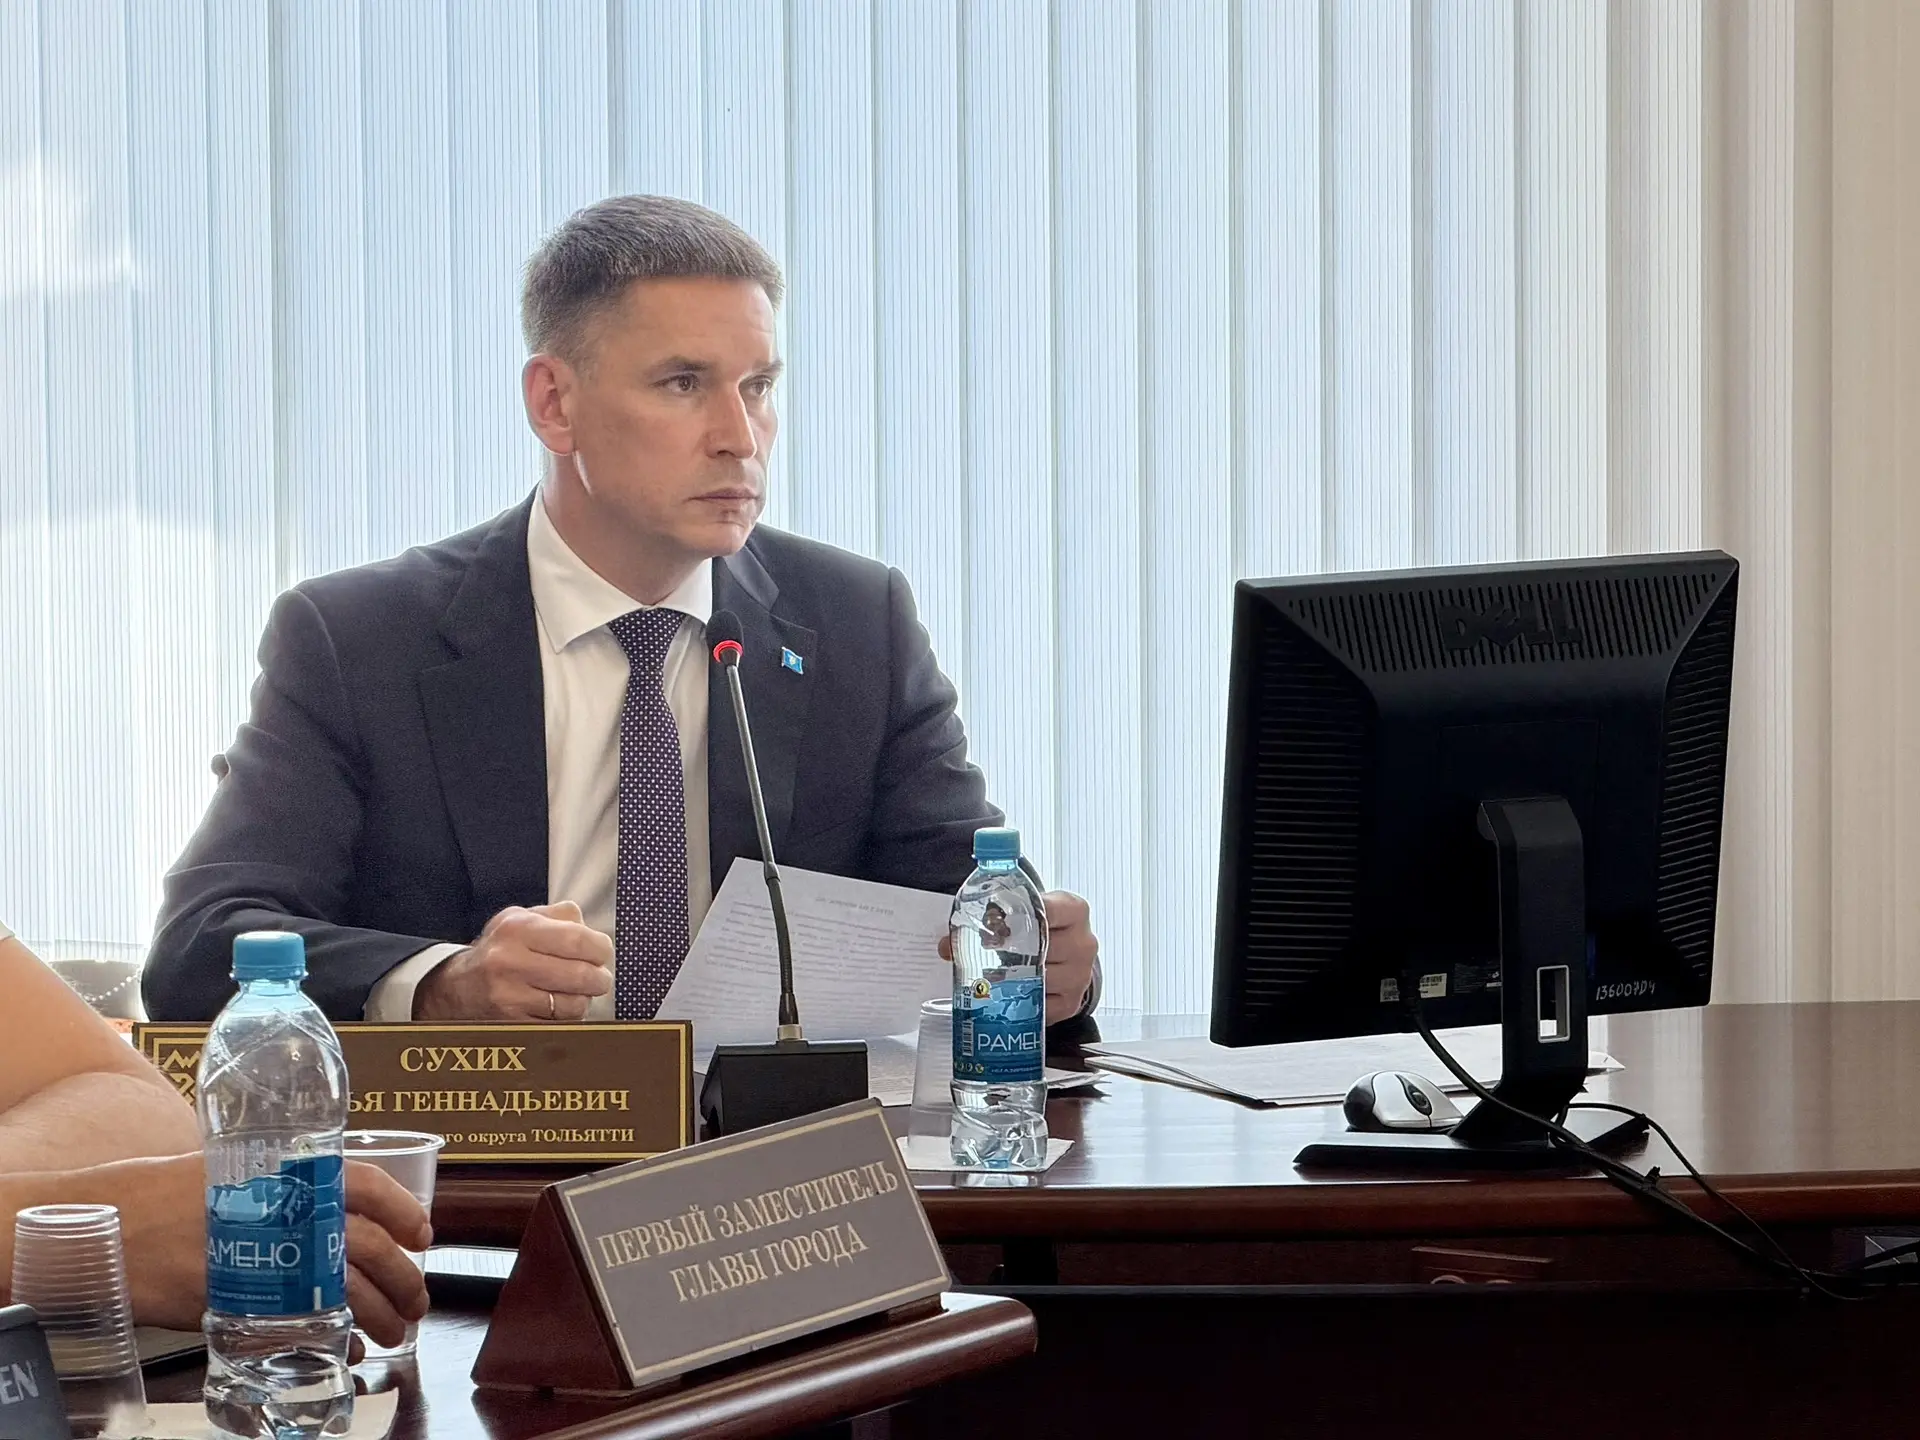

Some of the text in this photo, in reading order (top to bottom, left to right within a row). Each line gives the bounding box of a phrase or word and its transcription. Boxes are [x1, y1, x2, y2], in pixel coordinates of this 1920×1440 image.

[400, 1047, 527, 1072] СУХИХ
[342, 1090, 630, 1116] ЬЯ ГЕННАДЬЕВИЧ
[468, 1131, 527, 1146] округа
[531, 1128, 635, 1143] ТОЛЬЯТТИ
[596, 1160, 899, 1269] ПЕРВЫЙ ЗАМЕСТИТЕЛЬ
[206, 1237, 301, 1269] АМЕНО
[669, 1221, 870, 1302] ГЛАВЫ ГОРОДА
